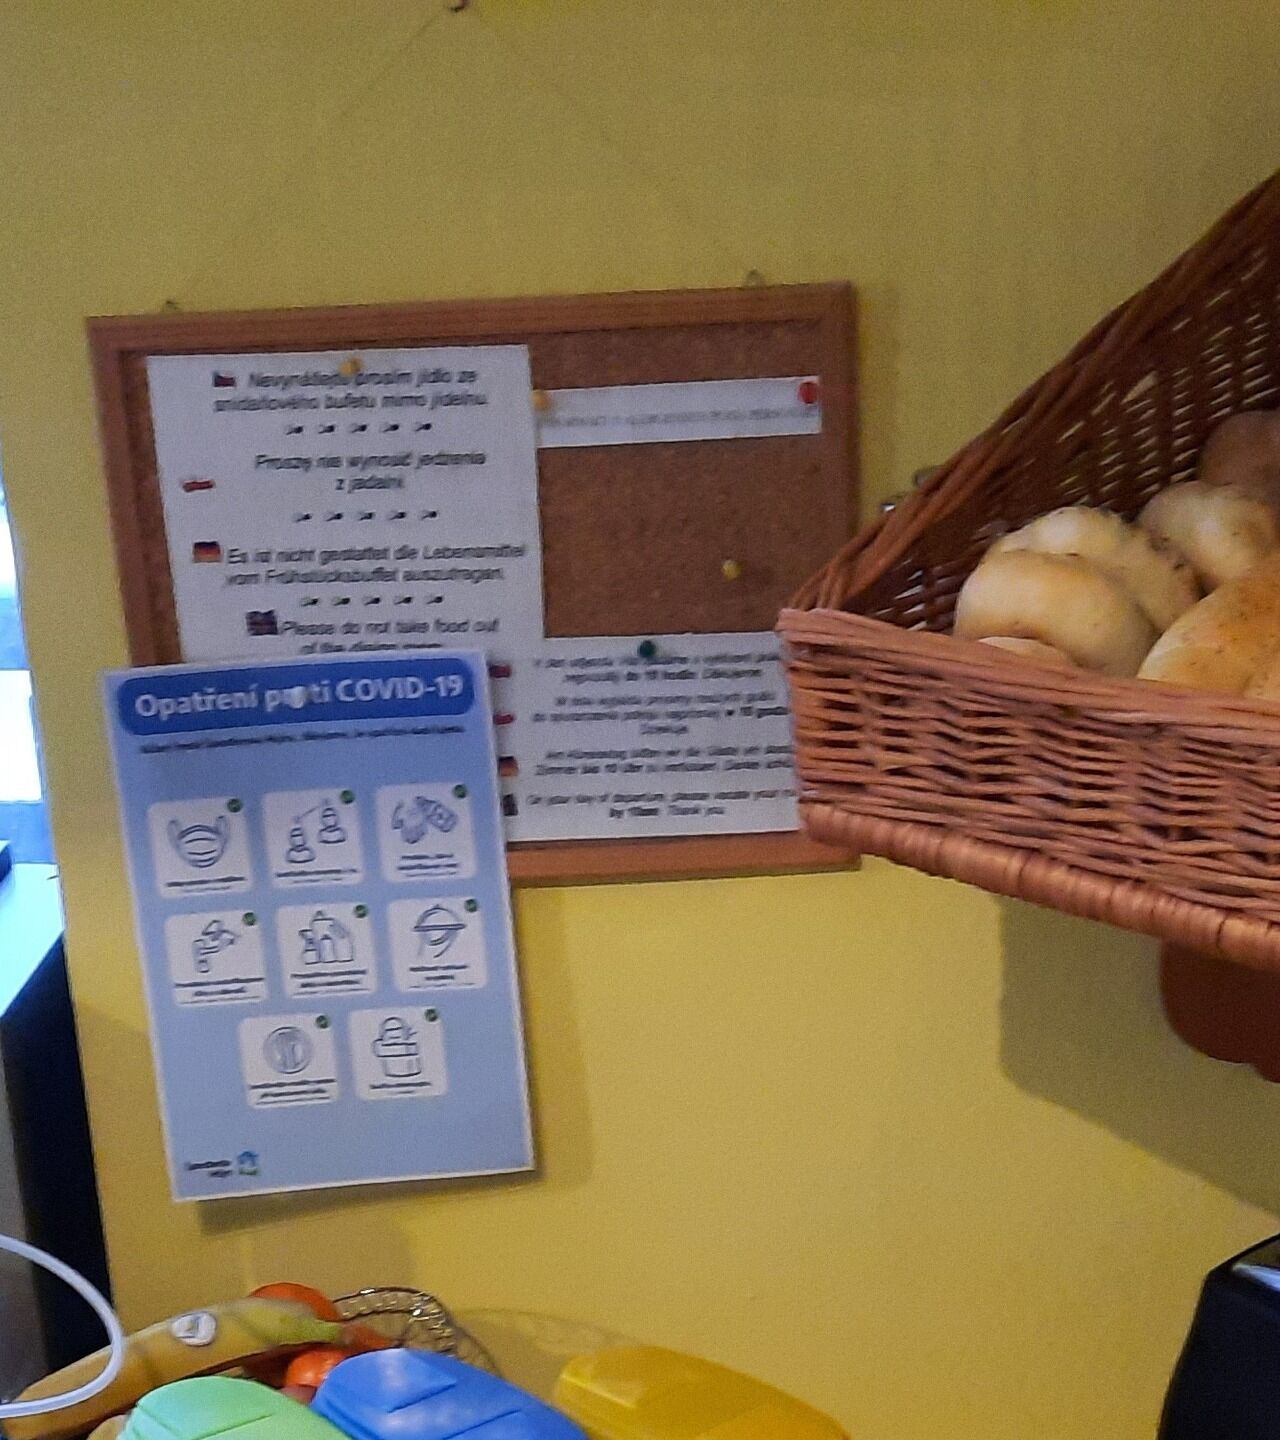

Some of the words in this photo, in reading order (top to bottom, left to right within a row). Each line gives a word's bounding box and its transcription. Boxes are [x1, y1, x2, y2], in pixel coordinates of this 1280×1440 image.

[457, 371, 477, 383] ze
[317, 456, 341, 468] nie
[335, 479, 345, 490] z
[228, 549, 248, 564] Es
[276, 549, 314, 562] nicht
[394, 545, 418, 560] die
[282, 620, 335, 635] Please
[342, 621, 360, 635] do
[365, 620, 391, 634] not
[395, 619, 430, 634] take
[435, 618, 469, 633] food
[474, 617, 500, 633] out
[300, 641, 318, 654] of
[321, 641, 345, 653] the
[135, 682, 259, 721] Opatření
[335, 674, 465, 702] COVID-19
